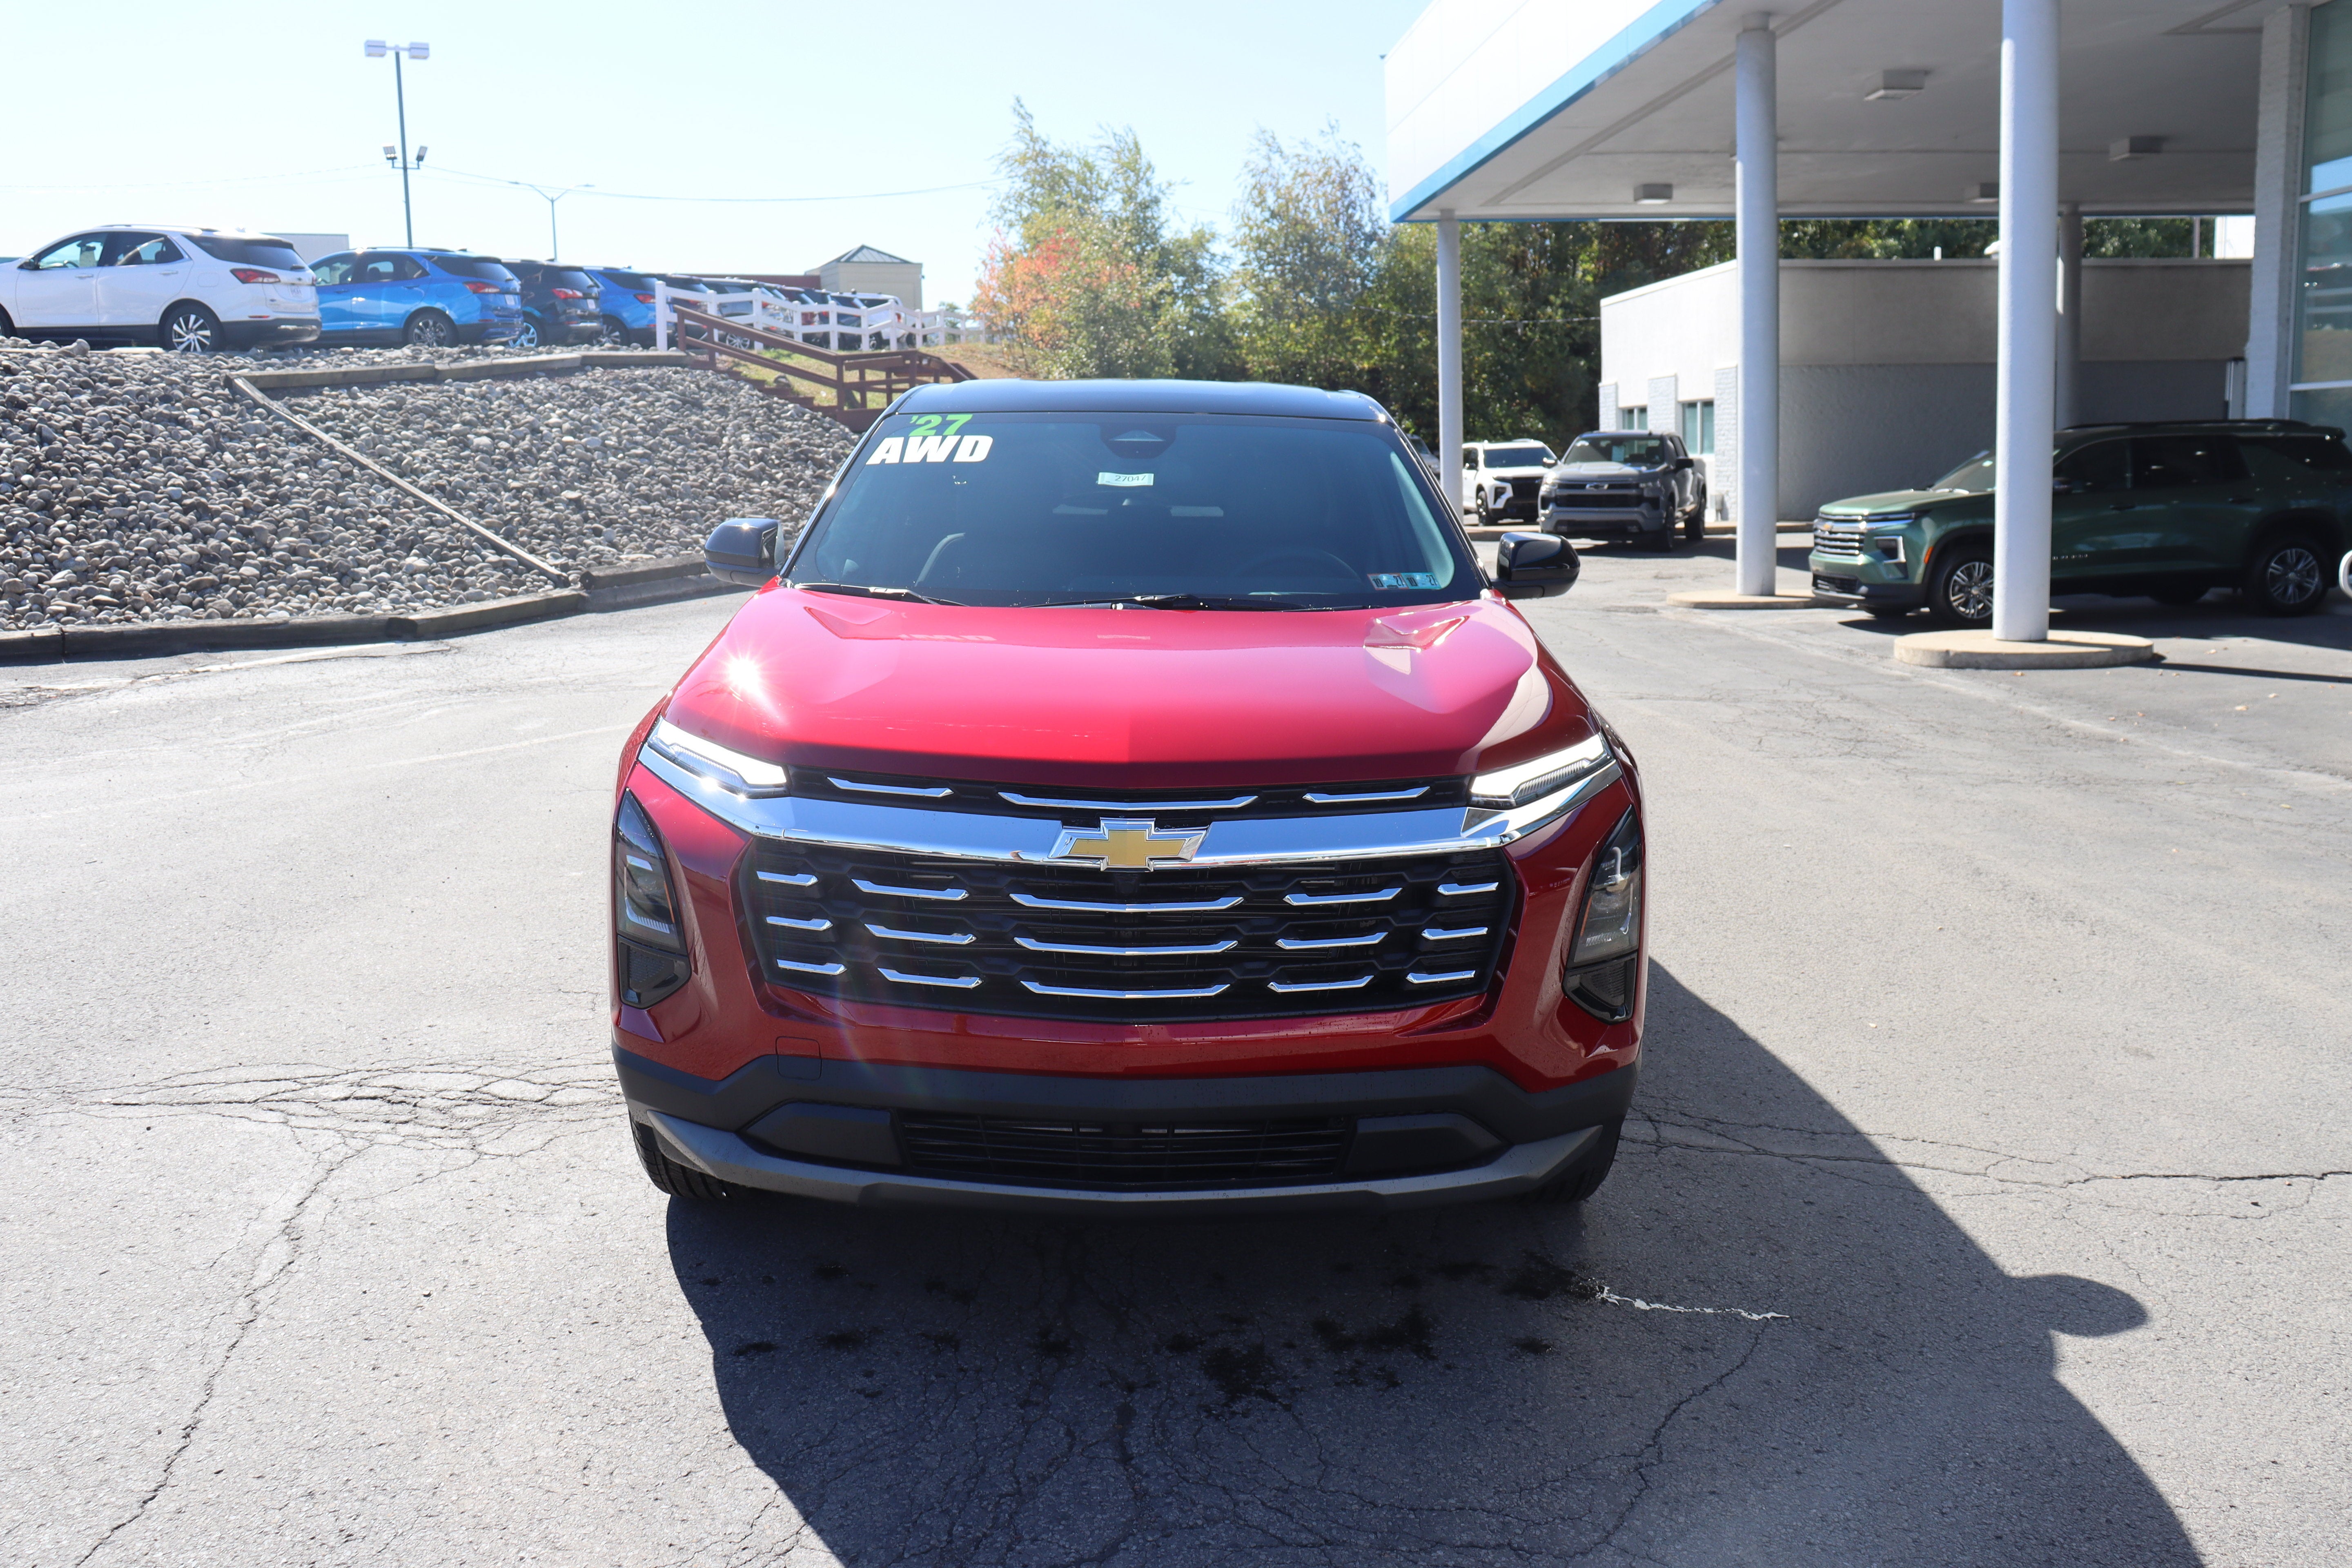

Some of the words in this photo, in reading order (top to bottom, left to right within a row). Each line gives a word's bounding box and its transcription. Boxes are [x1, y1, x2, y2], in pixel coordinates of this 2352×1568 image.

[866, 435, 993, 465] AWD
[1372, 578, 1384, 588] 10
[1393, 575, 1404, 587] 27
[1407, 577, 1418, 587] 10
[1426, 575, 1437, 586] 27
